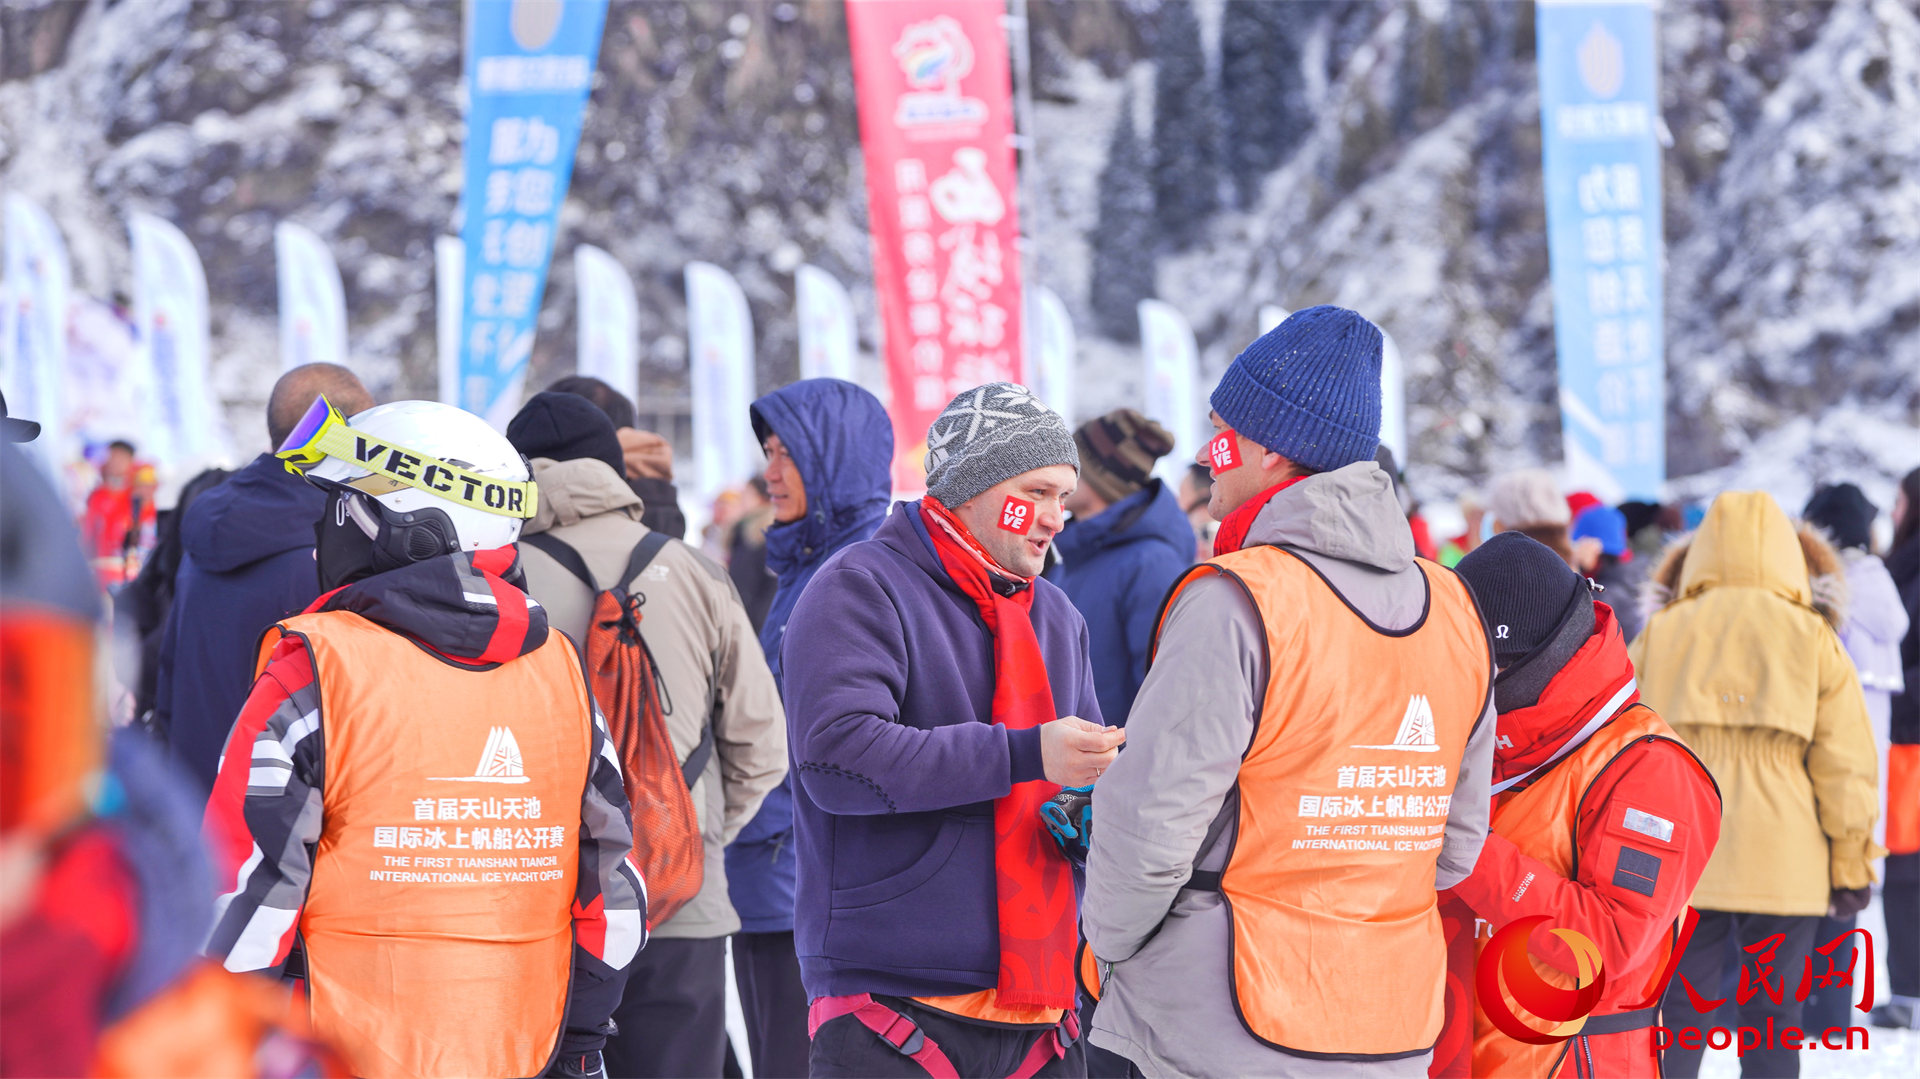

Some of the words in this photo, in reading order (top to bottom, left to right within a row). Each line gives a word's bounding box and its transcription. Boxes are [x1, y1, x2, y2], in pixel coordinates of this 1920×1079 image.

[355, 436, 523, 512] VECTOR
[1337, 765, 1447, 788] 首届天山天池
[412, 796, 542, 821] 首届天山天池
[1297, 794, 1453, 818] 国际冰上帆船公开
[373, 825, 566, 850] 国际冰上帆船公开赛
[1305, 824, 1331, 836] THE
[1332, 824, 1368, 836] FIRST
[1370, 824, 1427, 837] TIANSHAN
[1291, 839, 1391, 852] INTERNATIONAL
[1394, 841, 1413, 852] ICE
[382, 855, 411, 867] THE
[414, 857, 453, 868] FIRST
[457, 857, 518, 868] TIANSHAN
[520, 855, 558, 868] TIANCHI
[369, 870, 478, 883] INTERNATIONAL
[481, 871, 502, 883] ICE
[503, 871, 539, 883] YACHT
[539, 869, 564, 881] OPEN
